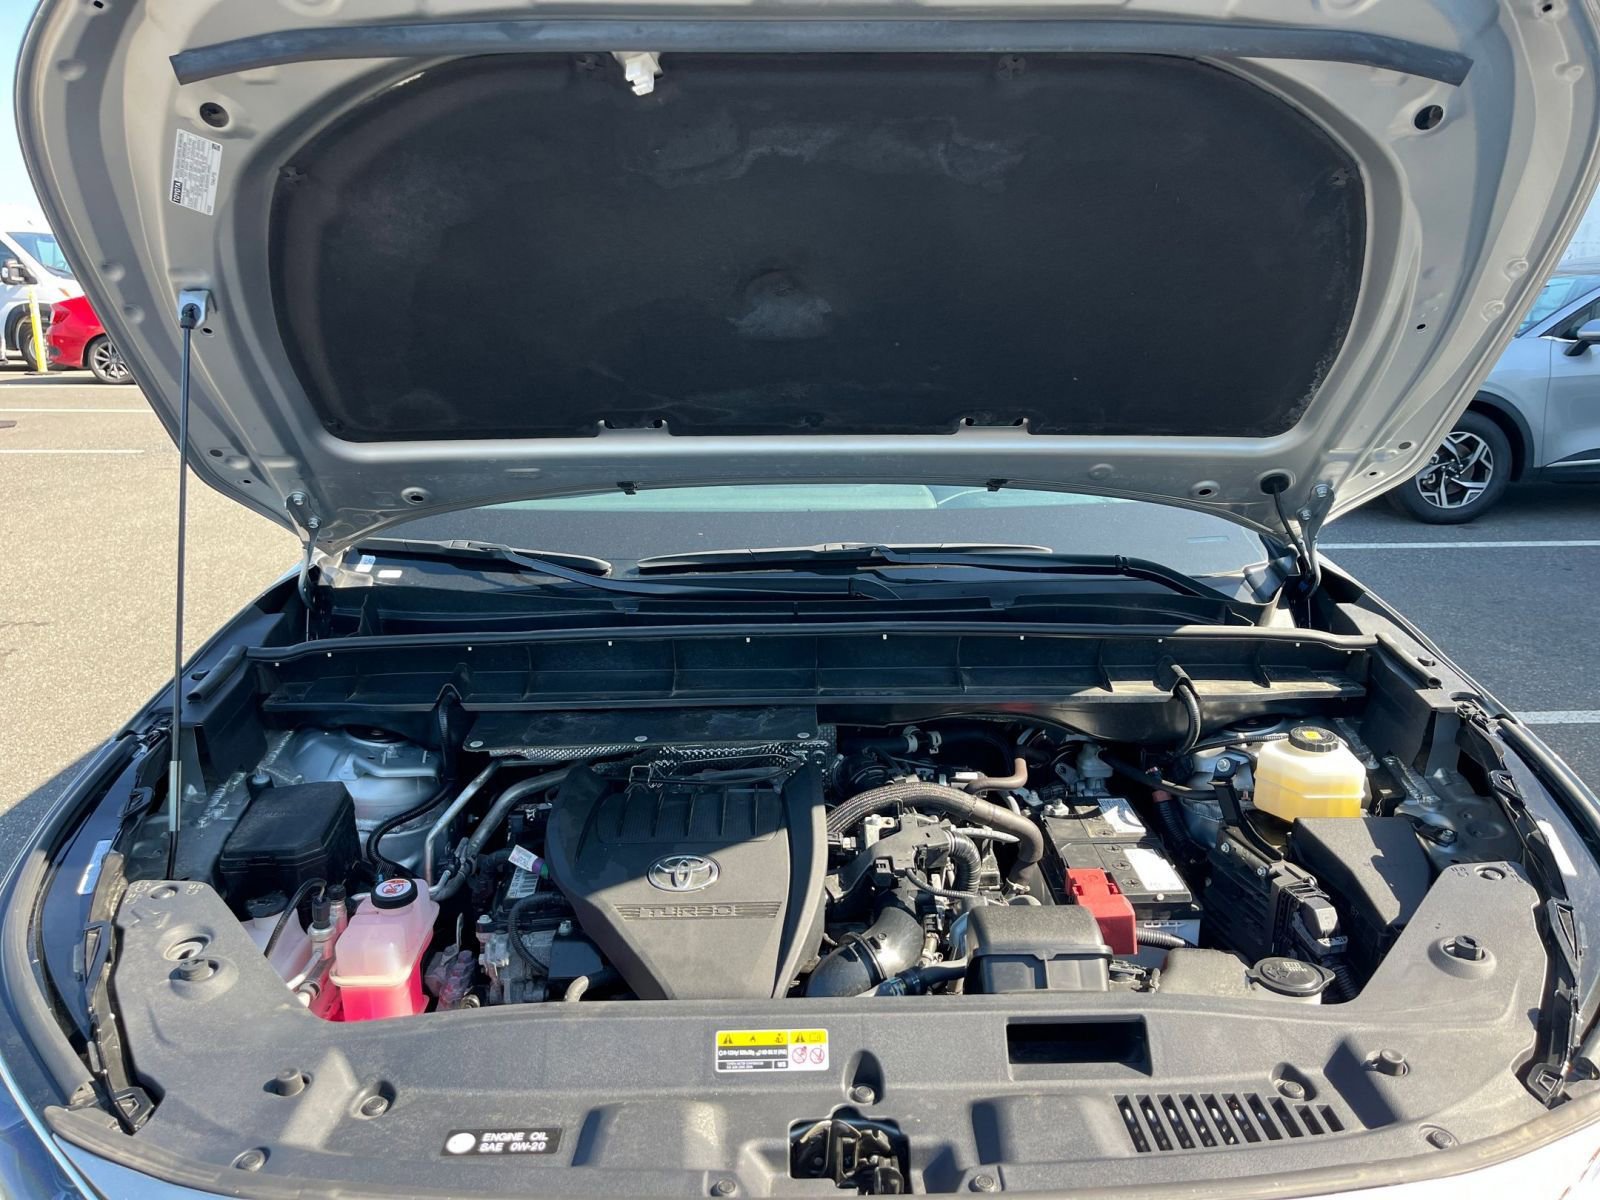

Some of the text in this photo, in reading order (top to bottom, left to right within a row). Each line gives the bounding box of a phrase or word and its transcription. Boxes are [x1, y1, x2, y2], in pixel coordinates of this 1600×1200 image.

[173, 182, 181, 202] TOYOTA
[641, 906, 733, 917] TURBO
[482, 1132, 549, 1141] ENGINE OIL
[479, 1142, 546, 1152] SAE 0W-20
